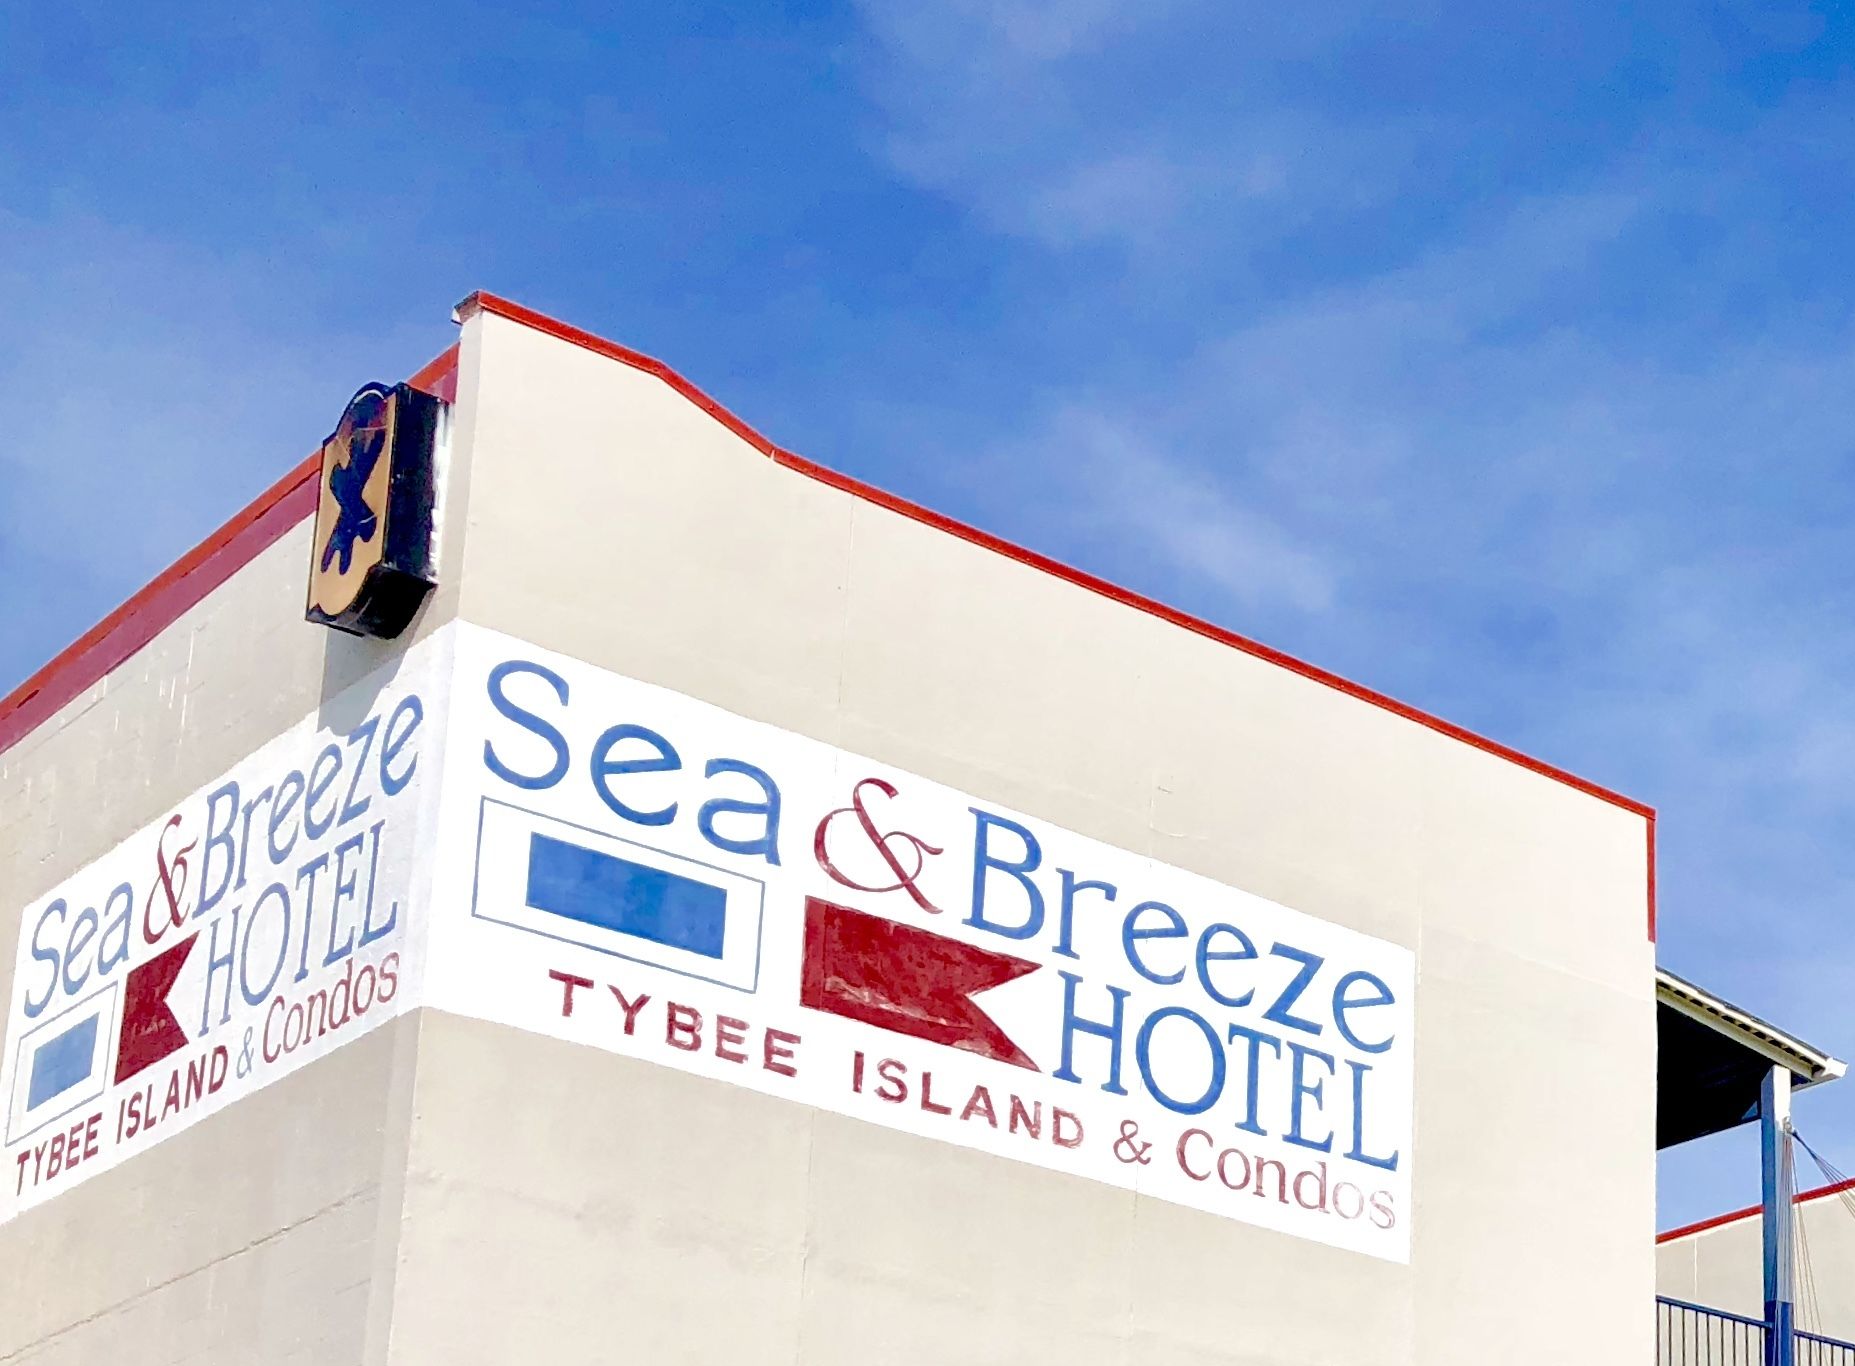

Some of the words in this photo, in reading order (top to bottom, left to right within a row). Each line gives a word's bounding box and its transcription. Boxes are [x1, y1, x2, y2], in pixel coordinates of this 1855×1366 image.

[24, 881, 134, 1017] Sea
[143, 812, 202, 944] &
[192, 694, 424, 919] Breeze
[198, 820, 399, 1037] HOTEL
[483, 659, 781, 866] Sea
[813, 777, 944, 914] &
[961, 806, 1396, 1054] Breeze
[17, 1111, 103, 1197] TYBEE
[116, 1045, 229, 1144] ISLAND
[235, 1026, 254, 1080] &
[263, 951, 401, 1064] Condos
[549, 969, 802, 1078] TYBEE
[852, 1050, 1084, 1149] ISLAND
[1113, 1119, 1152, 1166] &
[1176, 1128, 1396, 1230] Condos
[1052, 970, 1399, 1172] HOTEL
